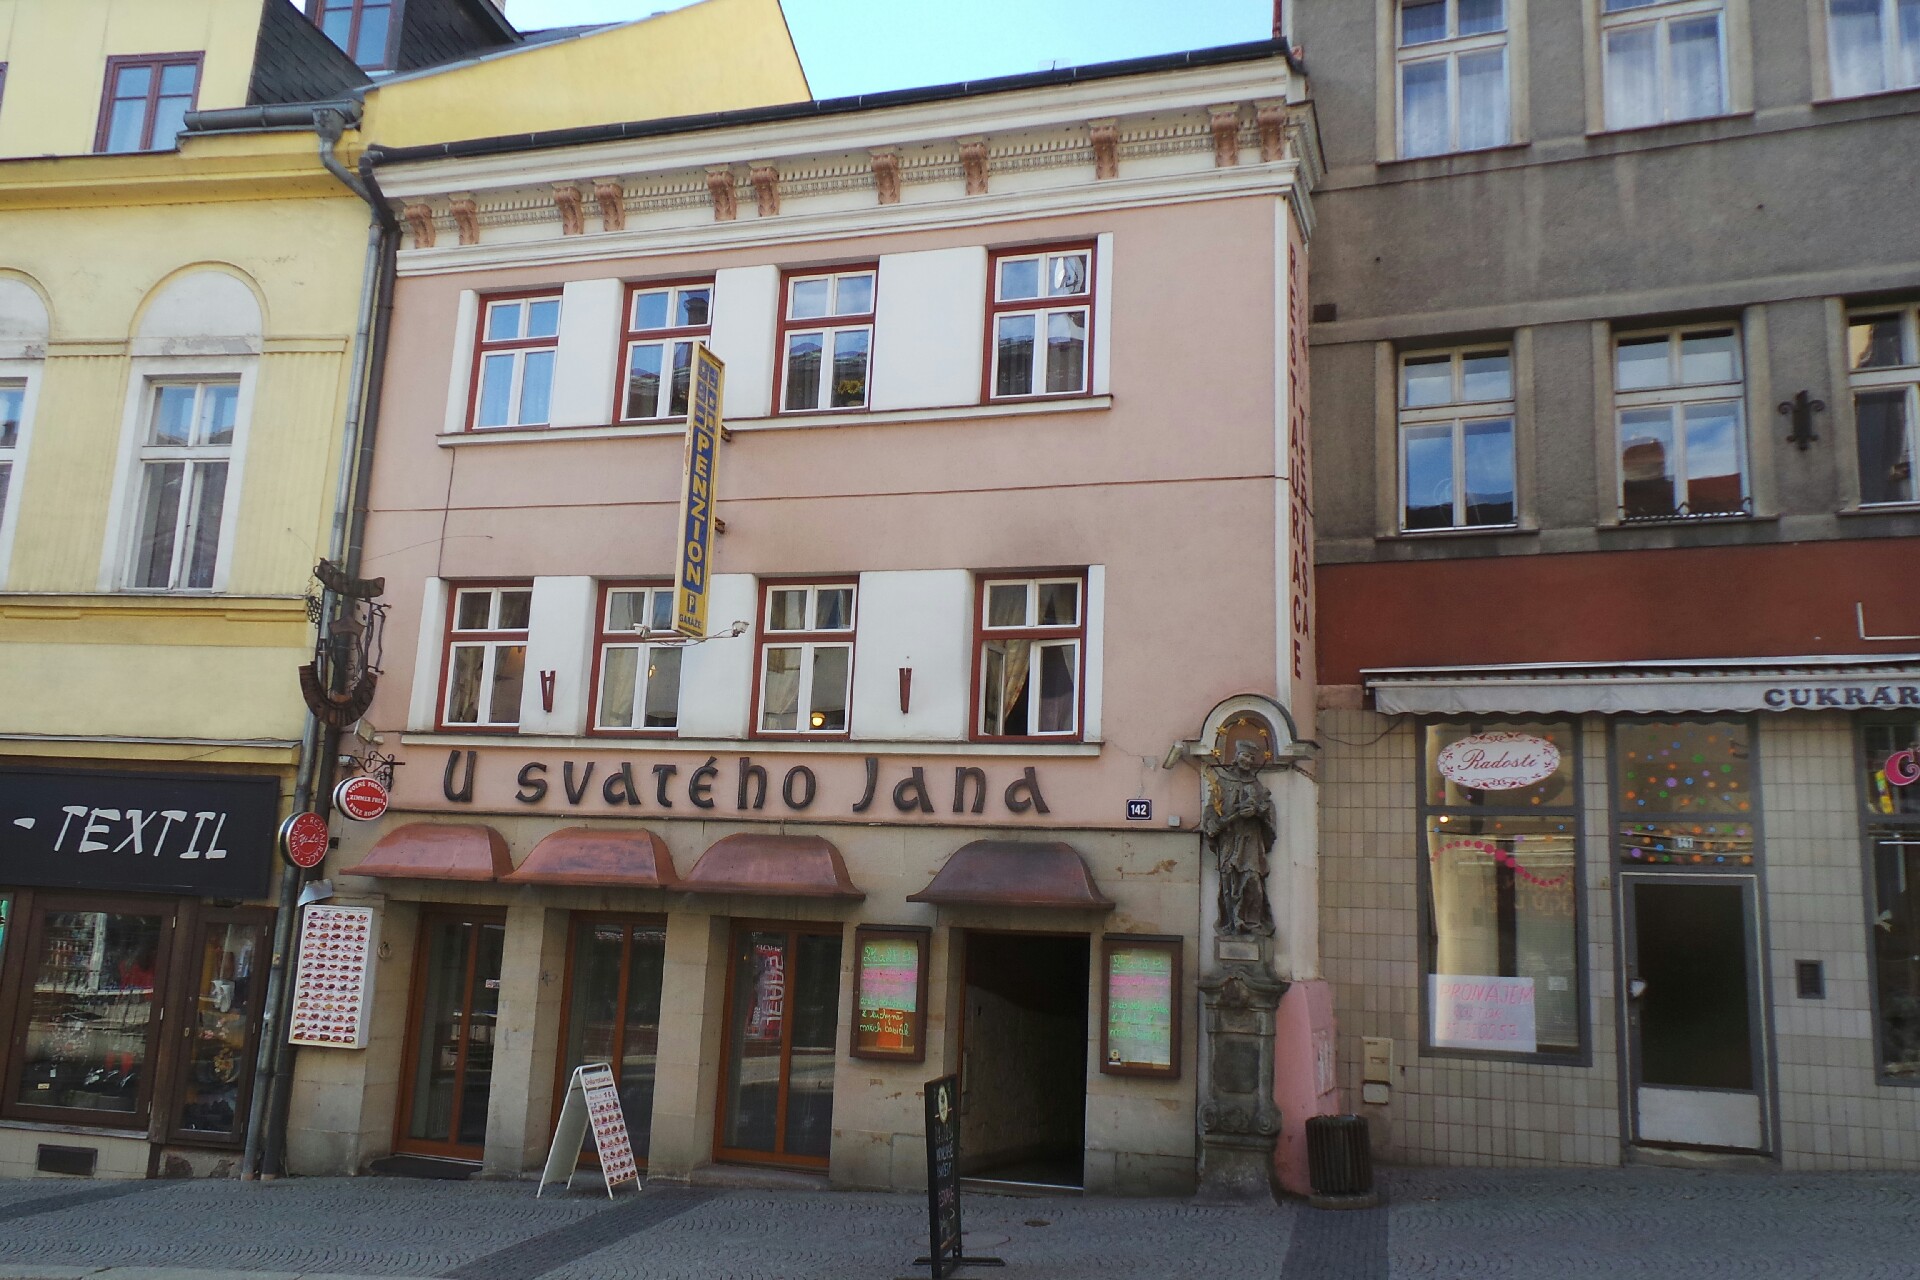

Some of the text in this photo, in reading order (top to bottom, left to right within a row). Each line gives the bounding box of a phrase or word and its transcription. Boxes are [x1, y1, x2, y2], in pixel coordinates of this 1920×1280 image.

[1290, 242, 1301, 680] RESTAURACE
[686, 432, 711, 586] PENZION
[1299, 404, 1310, 641] TERASA
[688, 595, 696, 611] P
[443, 750, 477, 802] U
[852, 757, 1051, 813] Jana
[1130, 804, 1147, 815] 142
[54, 805, 227, 859] TEXTIL
[305, 816, 326, 864] RESTAURACE
